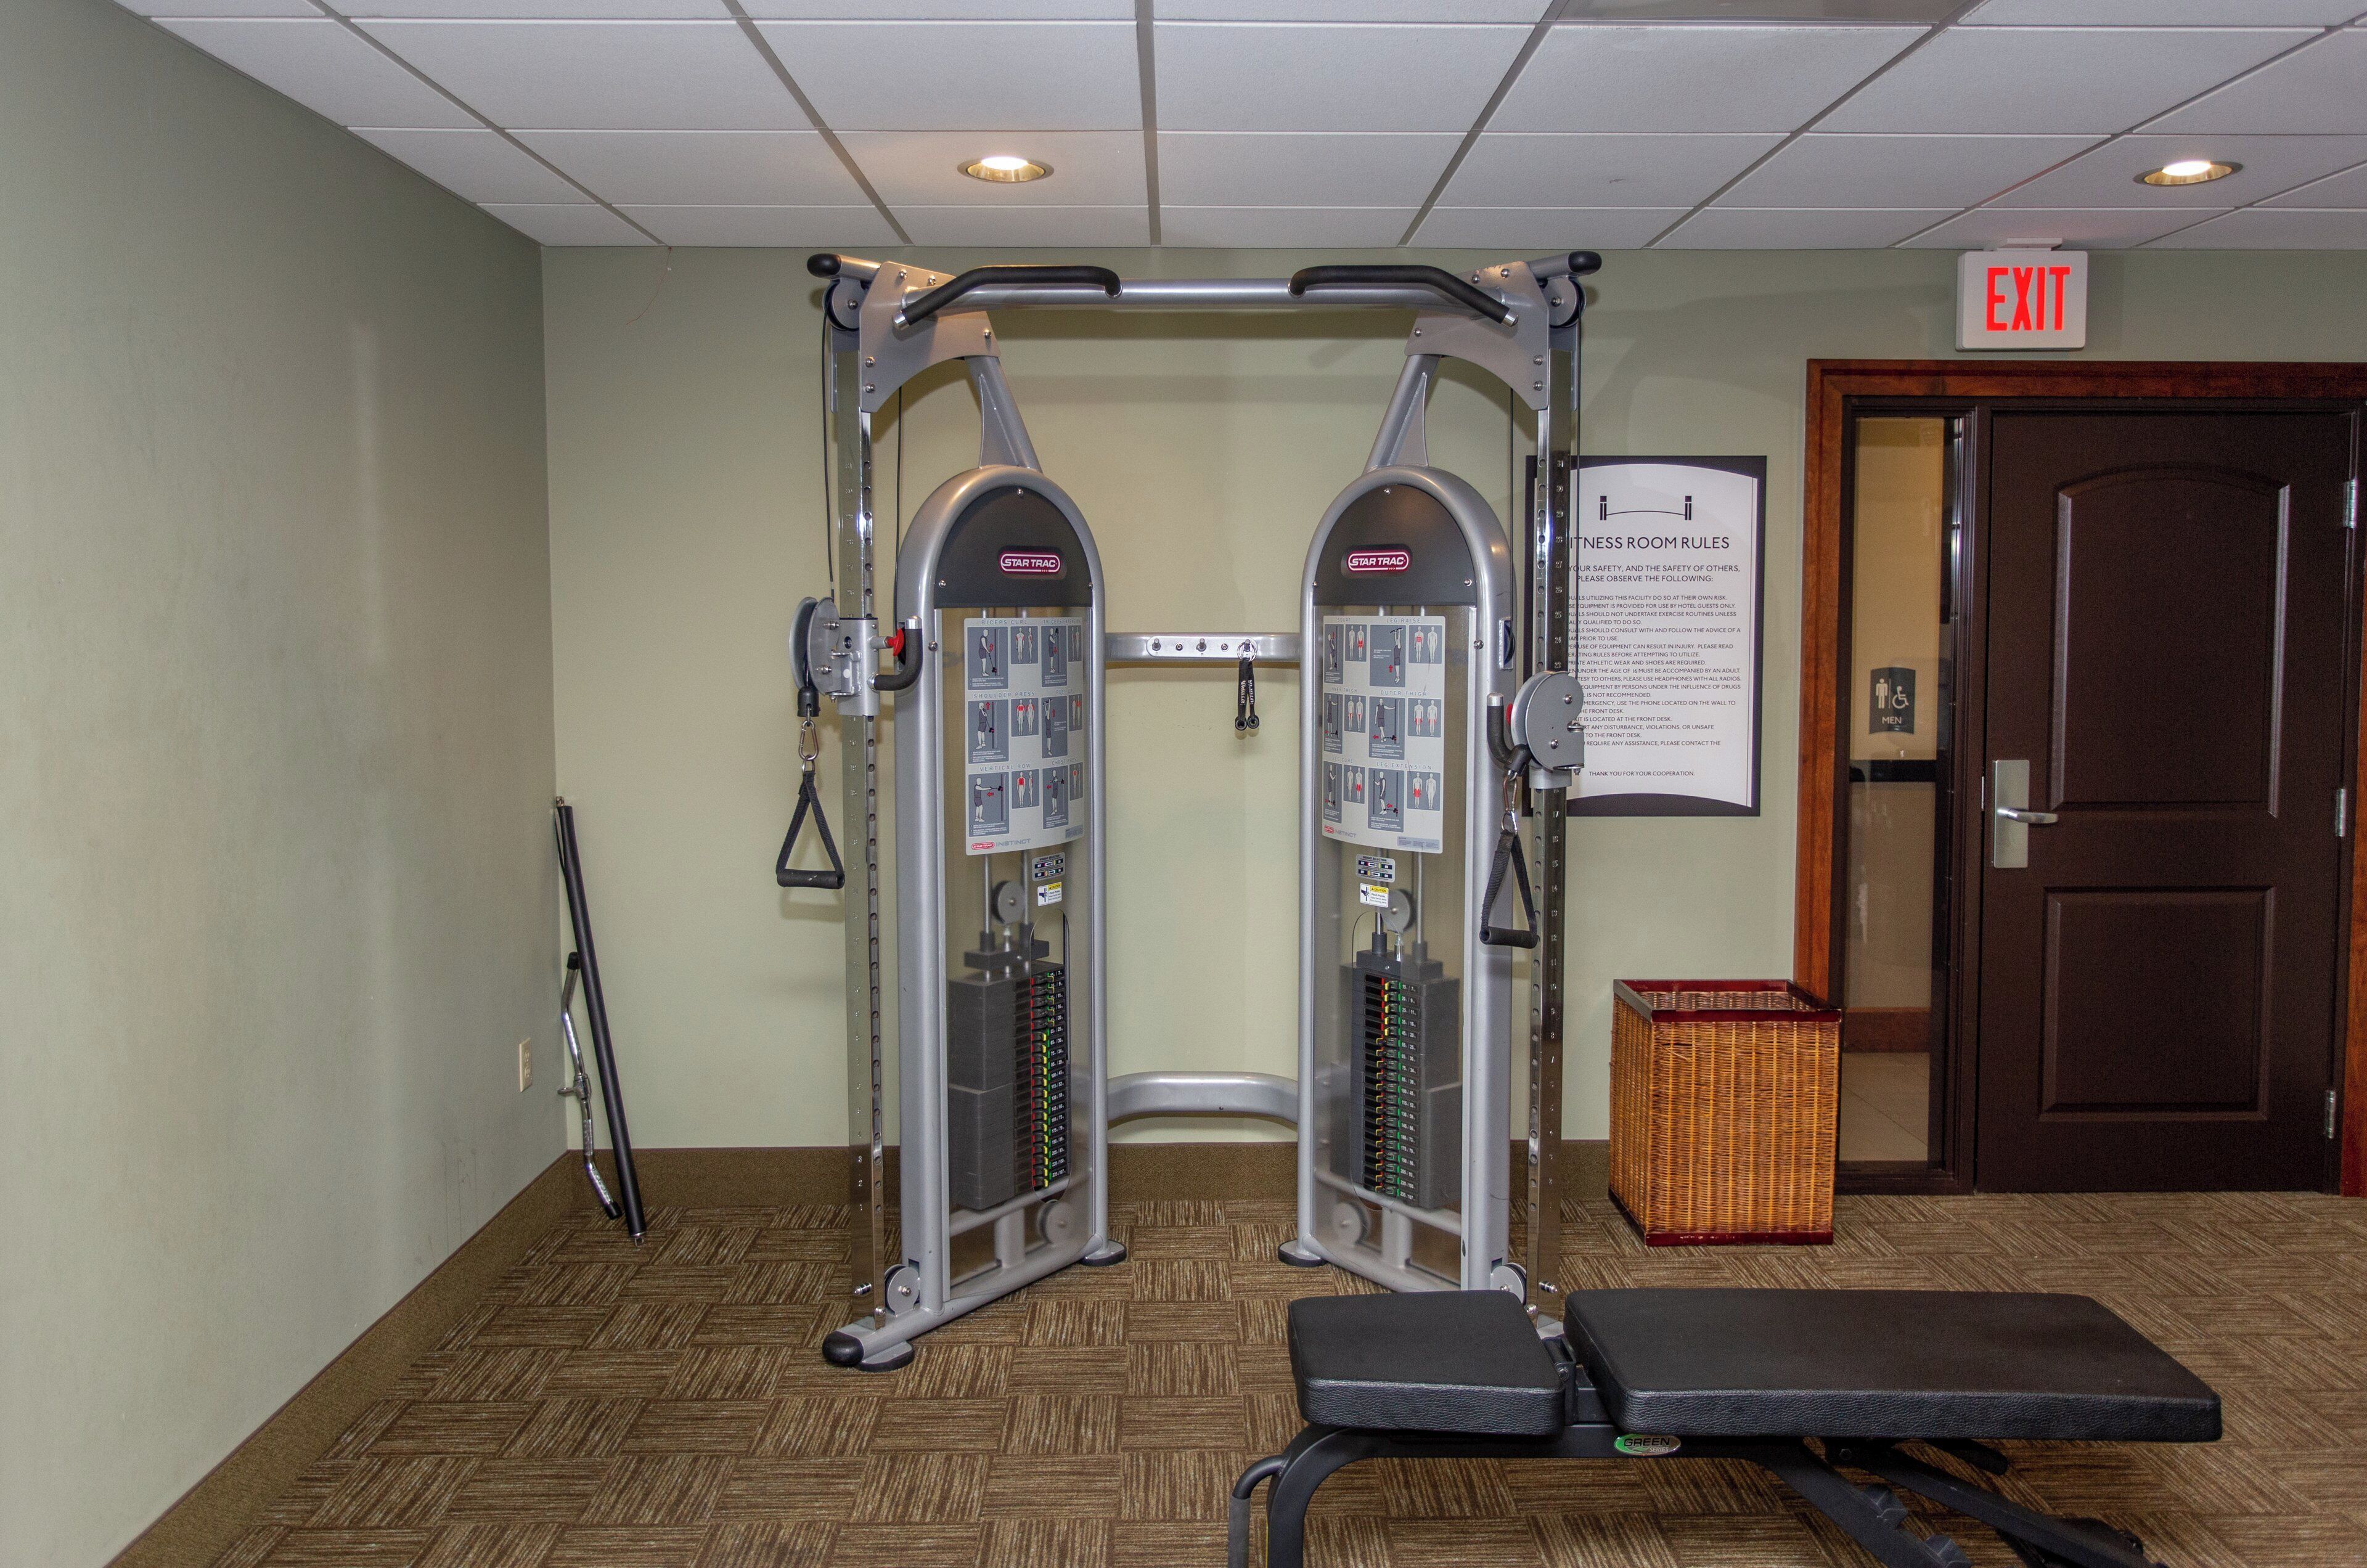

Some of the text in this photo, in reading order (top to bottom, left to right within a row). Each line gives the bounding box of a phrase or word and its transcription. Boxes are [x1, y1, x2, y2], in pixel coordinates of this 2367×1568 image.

[1985, 266, 2071, 332] EXIT
[1570, 536, 1730, 549] ITNESS ROOM RULES
[1004, 558, 1056, 568] STAR TRAC
[1351, 557, 1404, 566] STAR TRAC
[1592, 565, 1624, 573] SAFETY,
[1706, 565, 1741, 573] OTHERS,
[1578, 574, 1714, 582] PLEASE OBSERVE THE FOLLOWING:
[1881, 716, 1902, 724] MEN
[1623, 1437, 1670, 1447] GREEN
